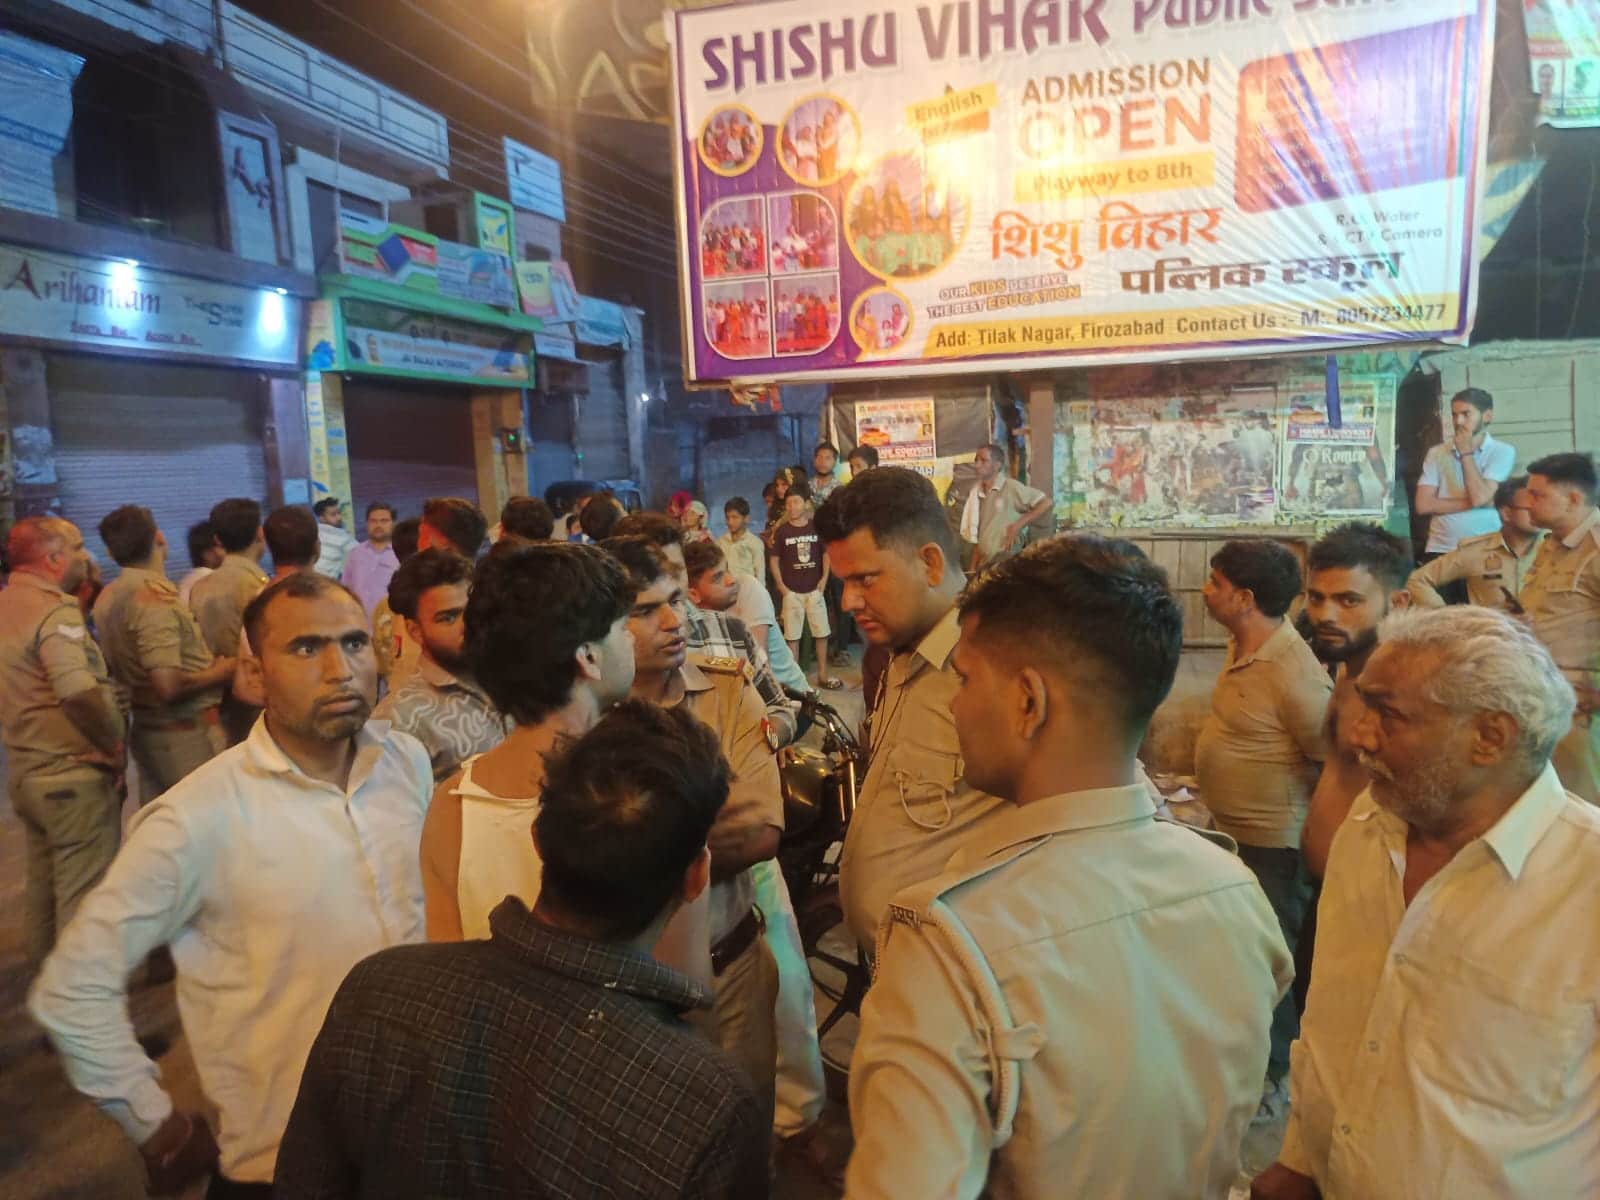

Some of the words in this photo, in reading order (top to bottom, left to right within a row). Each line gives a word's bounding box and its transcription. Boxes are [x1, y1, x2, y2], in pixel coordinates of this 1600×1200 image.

[702, 12, 897, 95] SHISHU
[1021, 56, 1210, 106] ADMISSION
[1018, 92, 1212, 161] OPEN
[1127, 167, 1149, 183] to
[1157, 161, 1193, 180] 8th
[990, 210, 1084, 271] शिशु
[939, 287, 968, 300] OUR
[969, 279, 1006, 297] KIDS
[1120, 257, 1269, 294] पब्लिक
[927, 303, 952, 319] THE
[986, 285, 1081, 311] EDUCATION
[936, 331, 971, 348] Add:
[979, 329, 1016, 345] Tilak
[1022, 325, 1074, 344] Nagar,
[1081, 319, 1164, 339] Firozabad
[1177, 314, 1247, 334] Contact
[1253, 313, 1276, 329] Us
